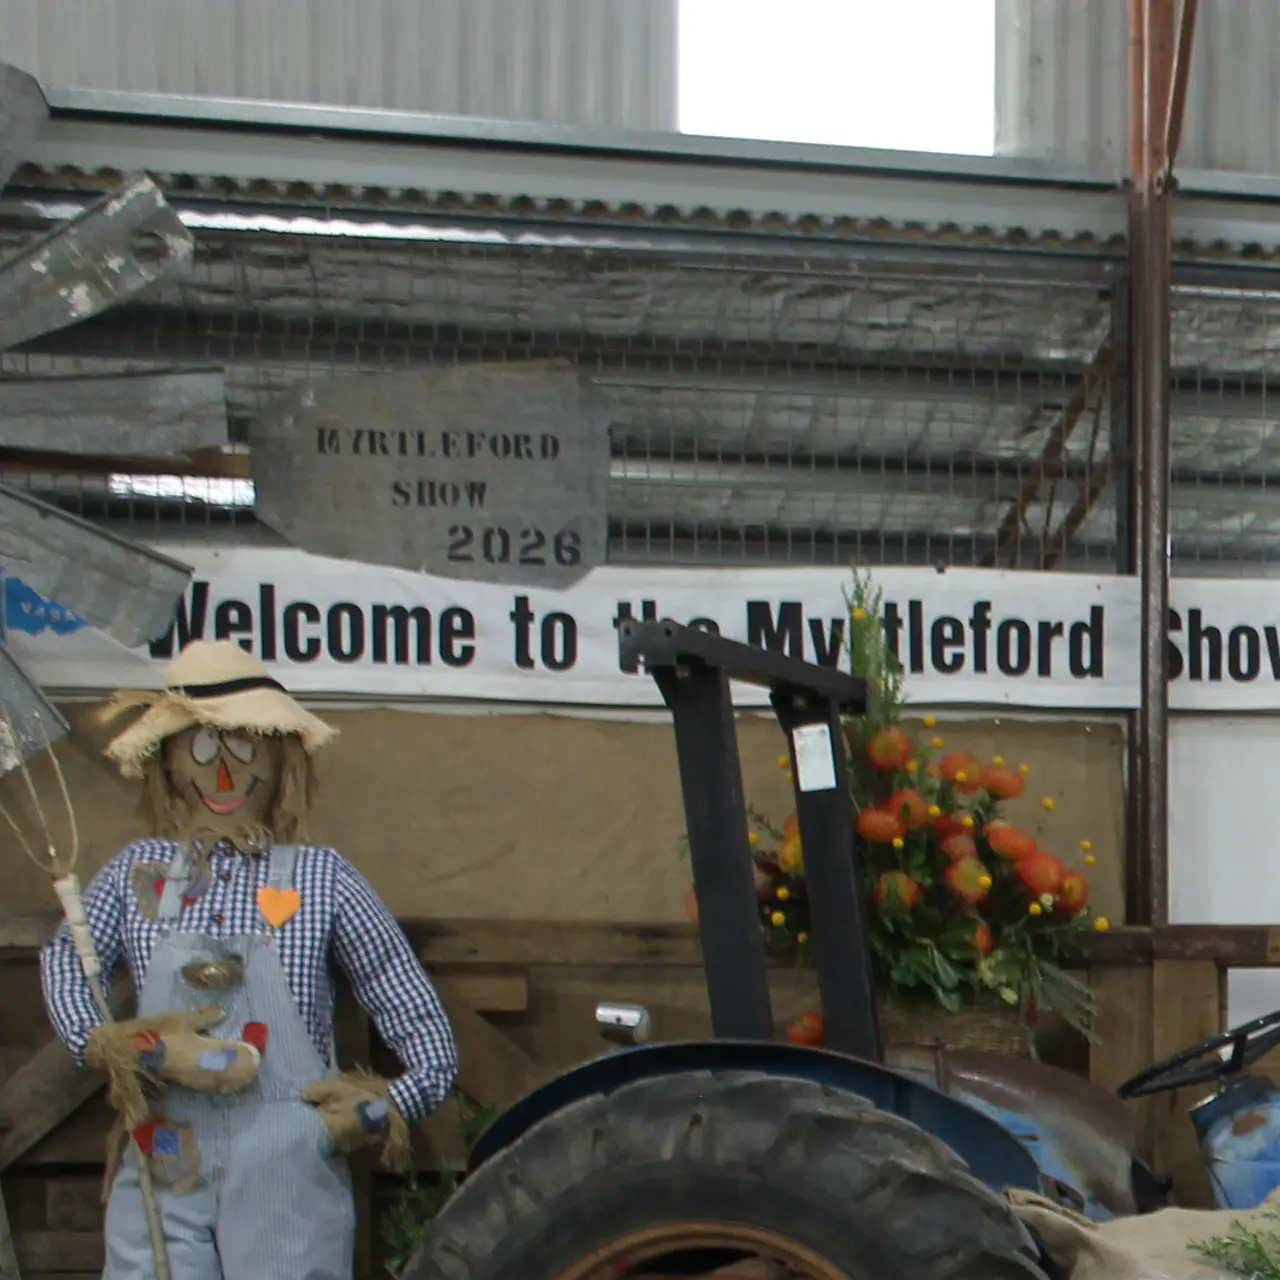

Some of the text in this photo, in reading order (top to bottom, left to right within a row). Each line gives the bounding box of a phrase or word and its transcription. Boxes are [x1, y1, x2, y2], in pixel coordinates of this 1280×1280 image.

[316, 427, 560, 460] MYRTLEFORD
[391, 480, 487, 508] SHOW
[447, 525, 582, 567] 2026
[510, 596, 578, 670] to
